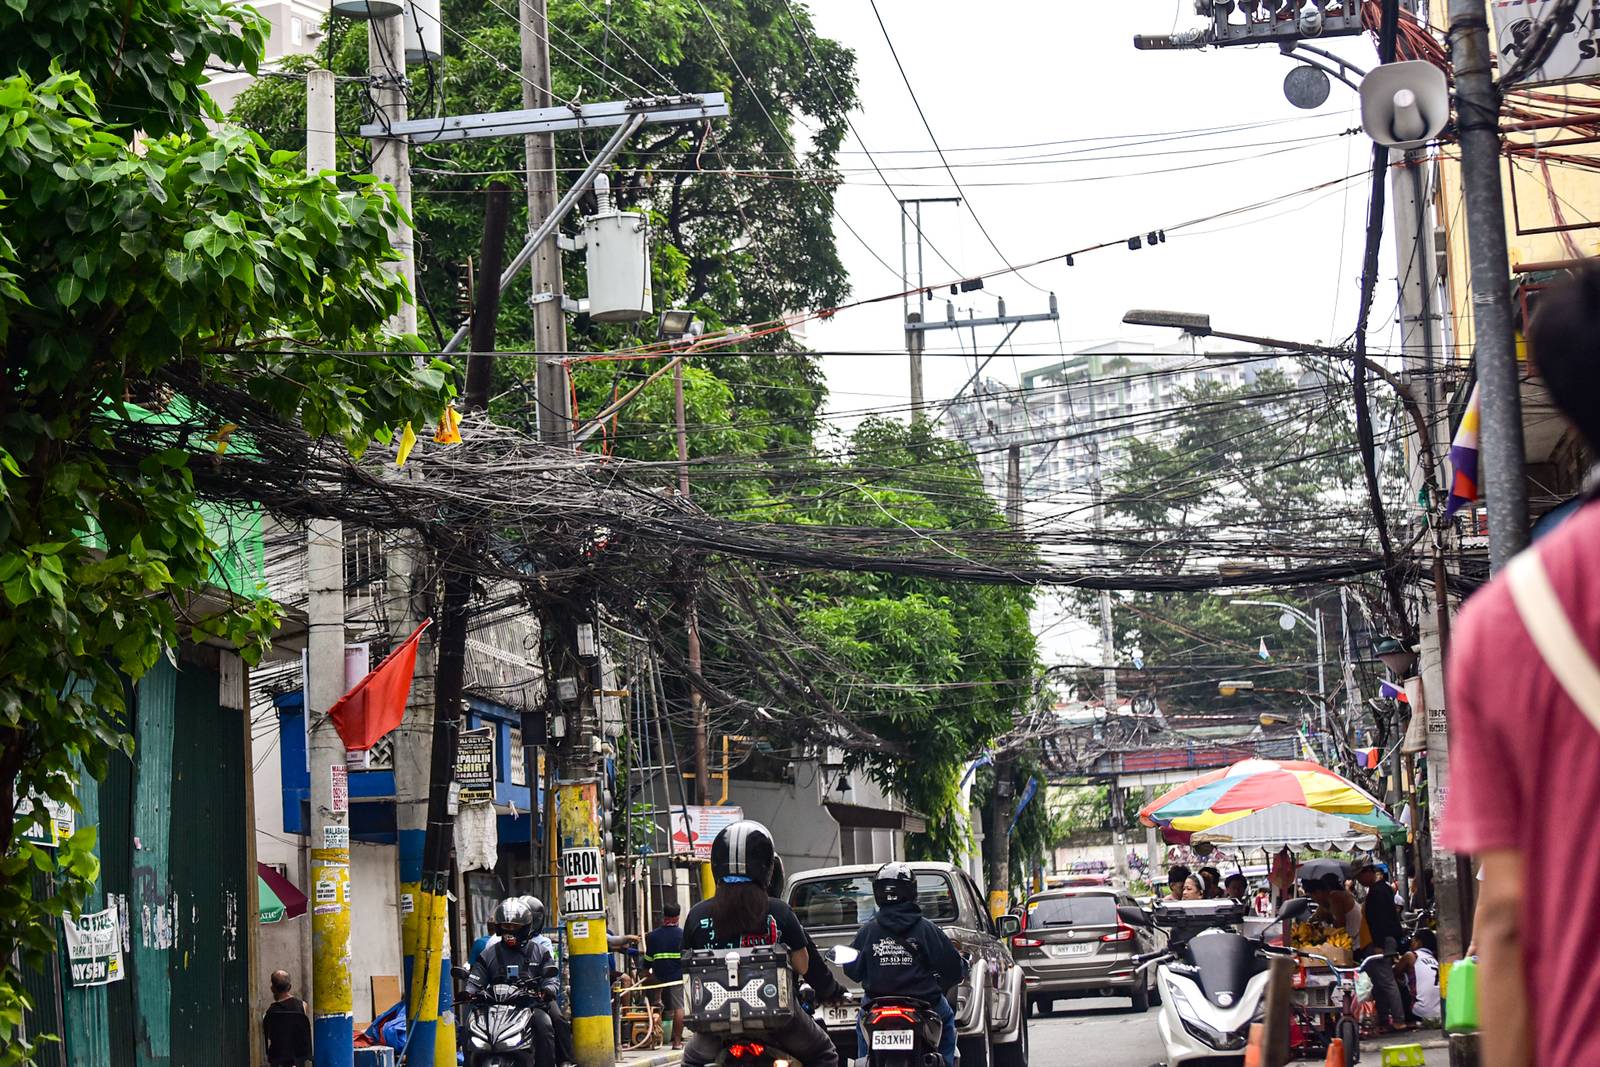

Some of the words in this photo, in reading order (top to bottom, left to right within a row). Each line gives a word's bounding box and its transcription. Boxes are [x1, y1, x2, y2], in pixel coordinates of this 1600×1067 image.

[456, 763, 489, 773] SHIRT
[563, 851, 598, 876] XEROX
[565, 888, 600, 911] PRINT
[73, 961, 107, 981] OYSEN
[874, 1034, 911, 1045] 581XWH
